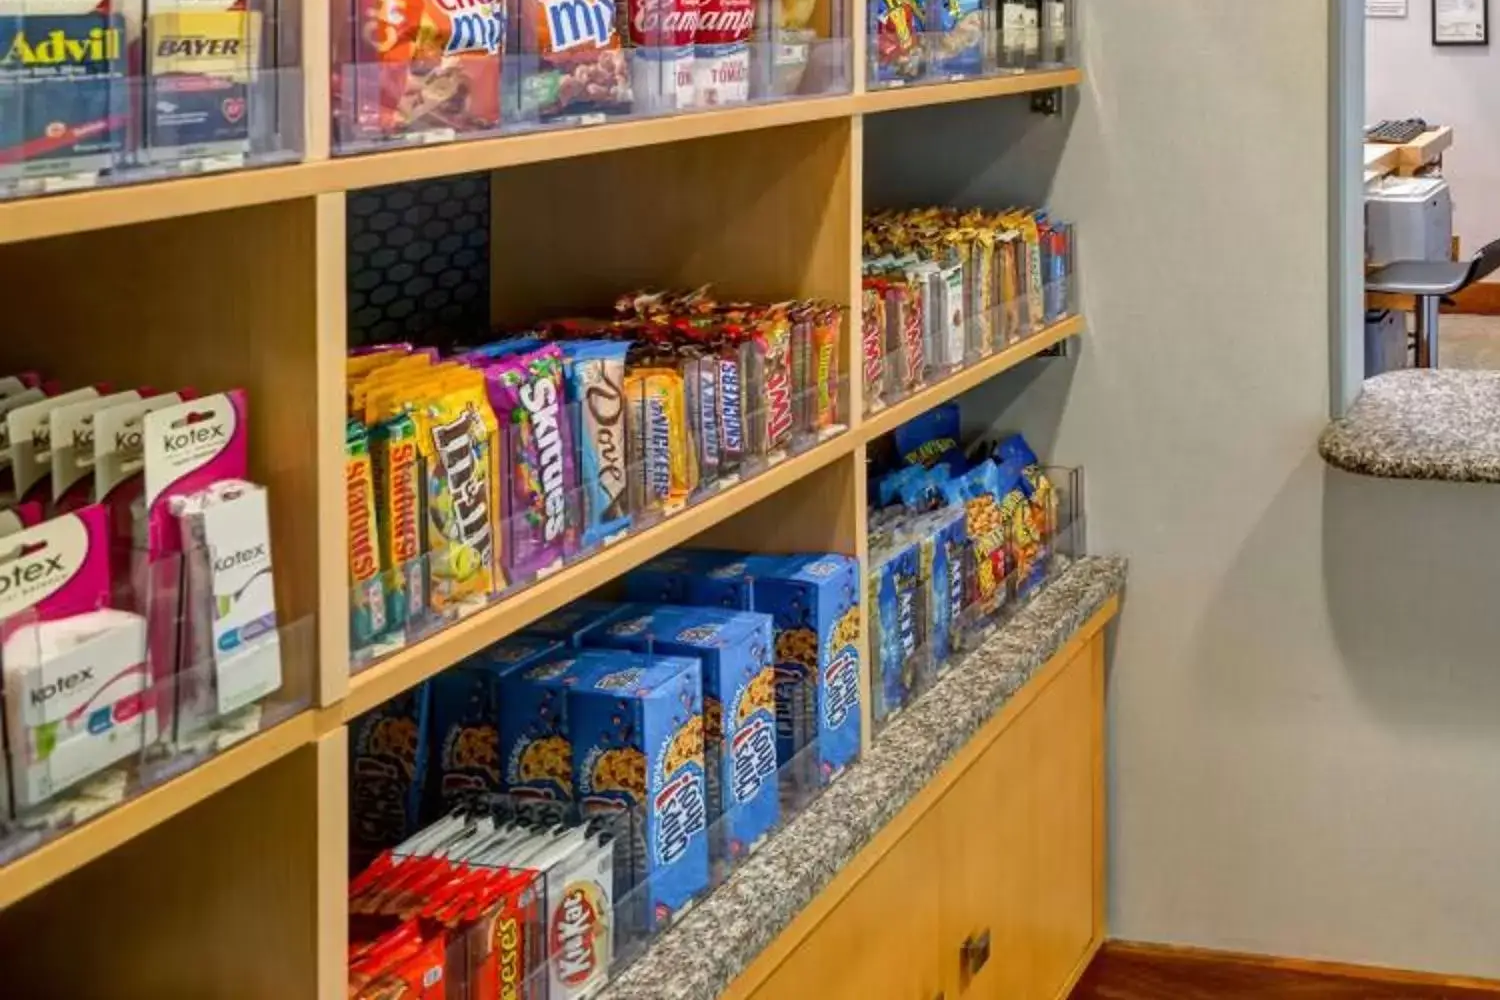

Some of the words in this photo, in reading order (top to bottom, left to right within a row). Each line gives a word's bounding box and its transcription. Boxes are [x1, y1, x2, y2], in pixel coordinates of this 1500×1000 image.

[2, 26, 120, 65] Advil
[158, 38, 240, 57] BAYER
[722, 363, 741, 448] SNICKERS
[519, 378, 564, 541] SKITTLES
[347, 459, 377, 582] Starburst
[391, 442, 417, 566] Starburst
[0, 552, 66, 595] otex
[498, 917, 517, 1000] eese's
